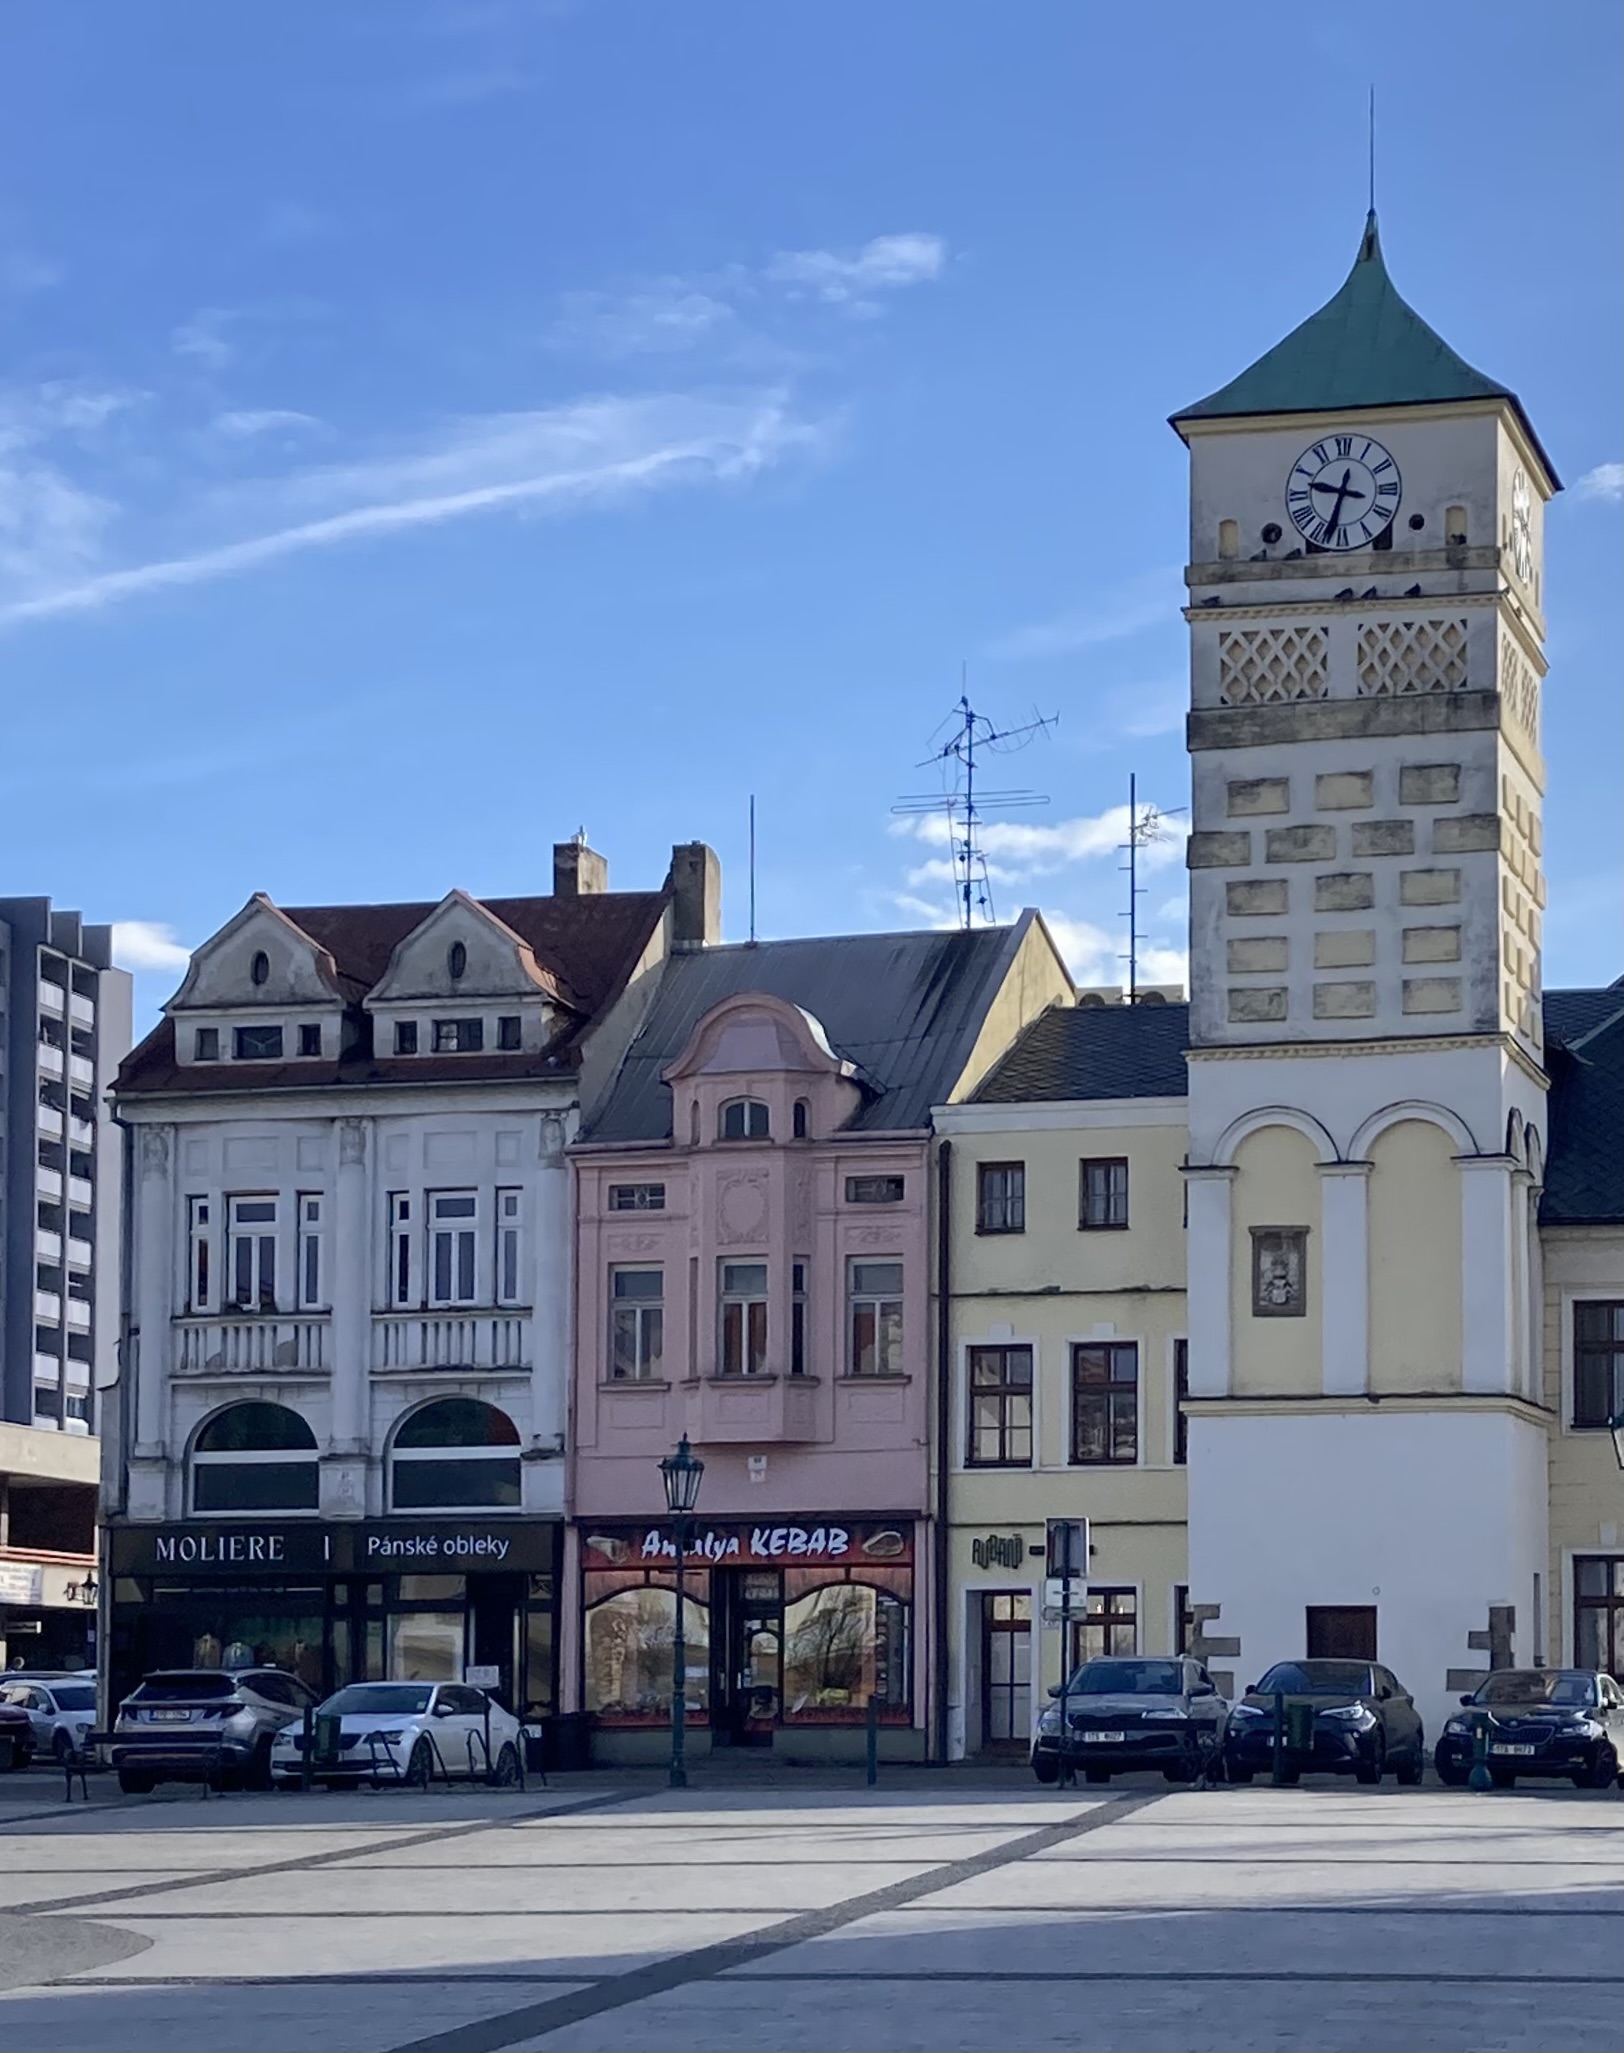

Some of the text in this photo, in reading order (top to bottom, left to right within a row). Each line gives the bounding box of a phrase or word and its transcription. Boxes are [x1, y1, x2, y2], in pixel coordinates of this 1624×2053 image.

[1334, 437, 1353, 456] XII
[156, 1535, 285, 1561] MOLIERE
[367, 1535, 438, 1556] Pánské
[443, 1534, 510, 1560] obleky
[641, 1527, 849, 1563] Analya KEBAB
